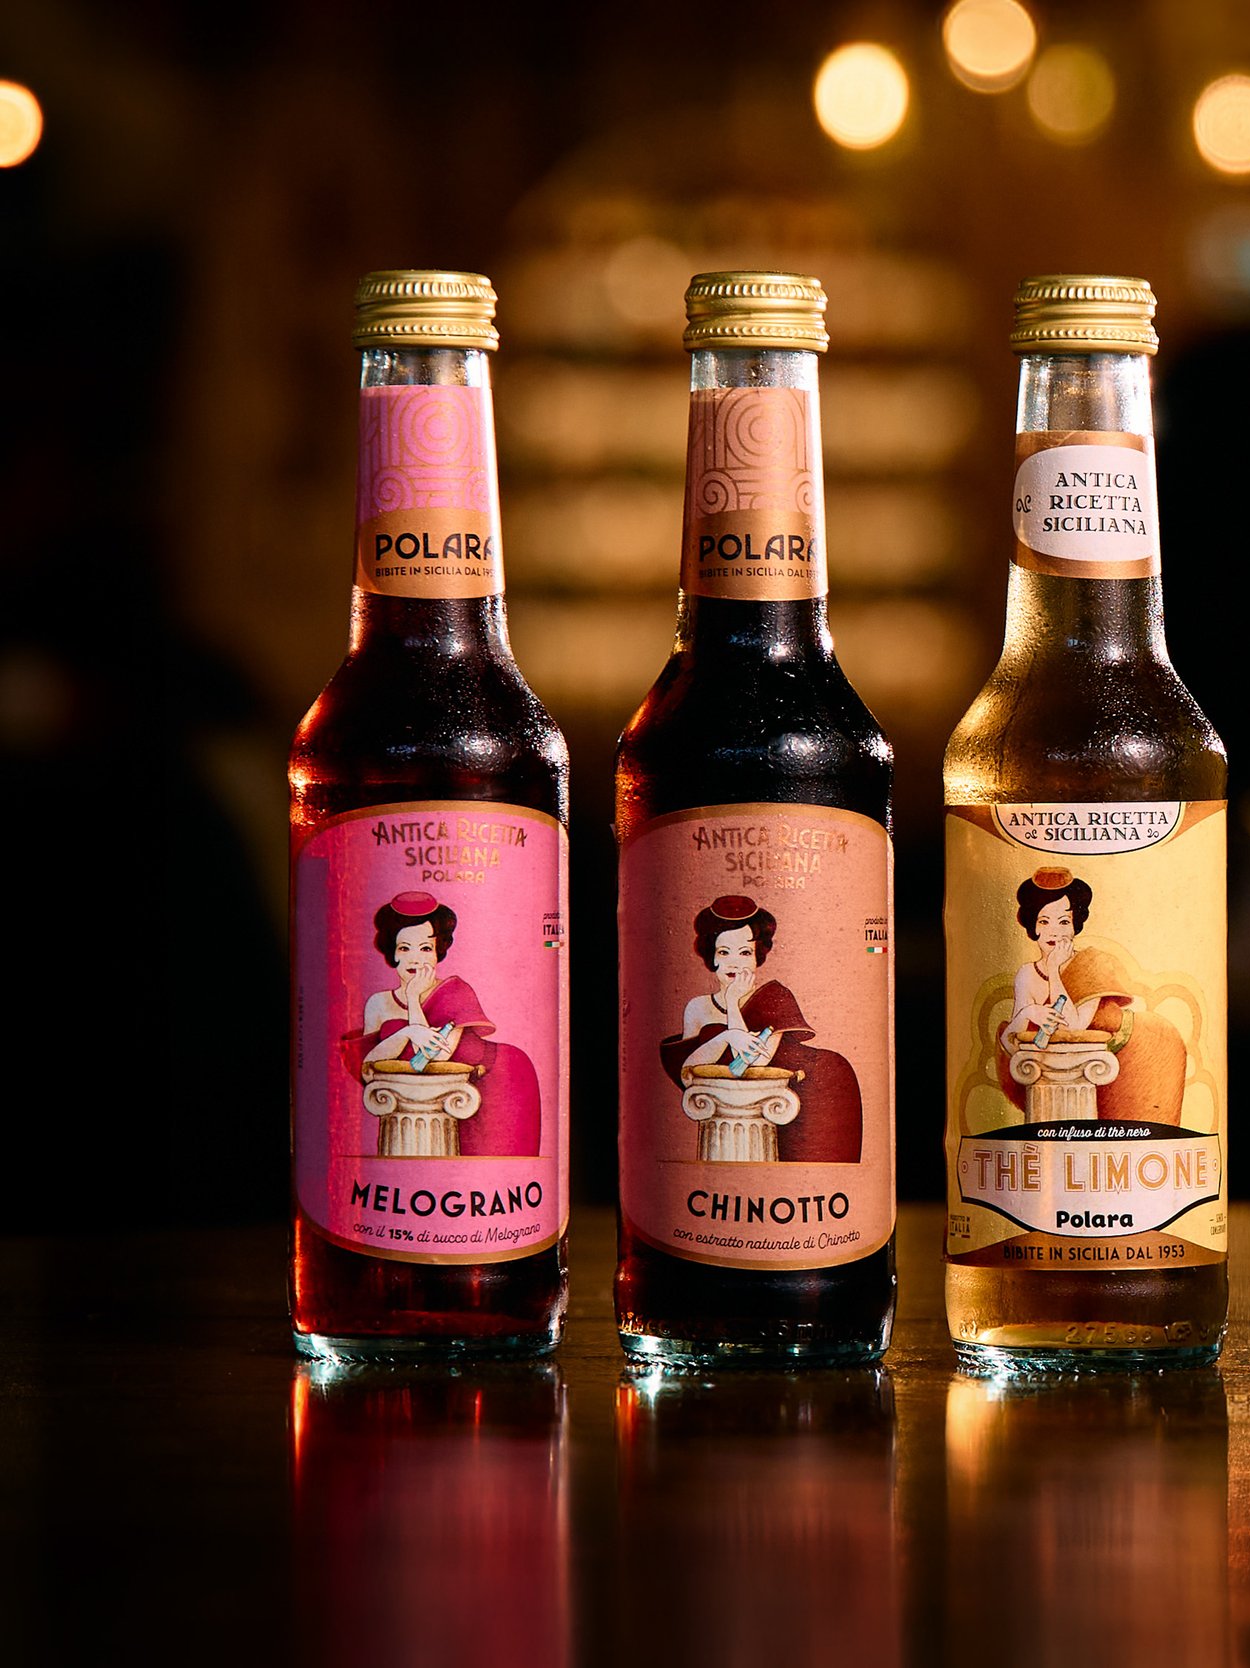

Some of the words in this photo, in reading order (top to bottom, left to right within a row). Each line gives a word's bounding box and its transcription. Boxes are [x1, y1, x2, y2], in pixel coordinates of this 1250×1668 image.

[1054, 472, 1138, 490] ANTICA
[1049, 494, 1143, 513] RICETTA
[1042, 516, 1147, 536] SICILIANA
[375, 532, 494, 561] POLARA
[375, 566, 406, 577] BIBITE
[409, 566, 421, 576] IN
[424, 566, 462, 576] SICILIA
[464, 566, 481, 577] DAL
[731, 567, 743, 577] IN
[746, 567, 784, 577] SICILIA
[787, 568, 804, 578] DAL
[1009, 812, 1080, 826] ANTICA
[1087, 811, 1169, 826] RICETTA
[372, 820, 449, 847] ANTICA
[456, 817, 528, 848] RICETTA
[692, 826, 771, 851] ANTICA
[1043, 827, 1142, 841] SICILIANA
[405, 846, 500, 868] SICILIANA
[865, 929, 888, 941] ITALIA
[1037, 1128, 1057, 1138] con
[1058, 1126, 1093, 1141] infuso
[1094, 1126, 1107, 1138] di
[1107, 1125, 1125, 1138] thè
[1126, 1128, 1151, 1138] nero
[972, 1143, 1042, 1193] THÈ
[1063, 1149, 1209, 1194] LIMONE
[350, 1178, 543, 1218] MELOGRANO
[687, 1189, 850, 1225] CHINOTTO
[1056, 1210, 1134, 1229] Polara
[353, 1223, 374, 1236] con
[375, 1225, 386, 1238] il
[388, 1228, 414, 1242] 15%
[417, 1229, 431, 1243] di
[432, 1234, 468, 1244] succo
[470, 1230, 484, 1243] di
[484, 1223, 541, 1244] Melograno
[673, 1228, 693, 1242] con
[695, 1232, 744, 1249] estratto
[745, 1236, 801, 1250] naturale
[803, 1235, 816, 1250] di
[818, 1228, 861, 1250] Chinotto
[1003, 1246, 1044, 1261] BIBITE
[1050, 1246, 1063, 1260] IN
[1068, 1246, 1120, 1261] SICILIA
[1126, 1246, 1153, 1260] DAL
[1158, 1244, 1185, 1258] 1953
